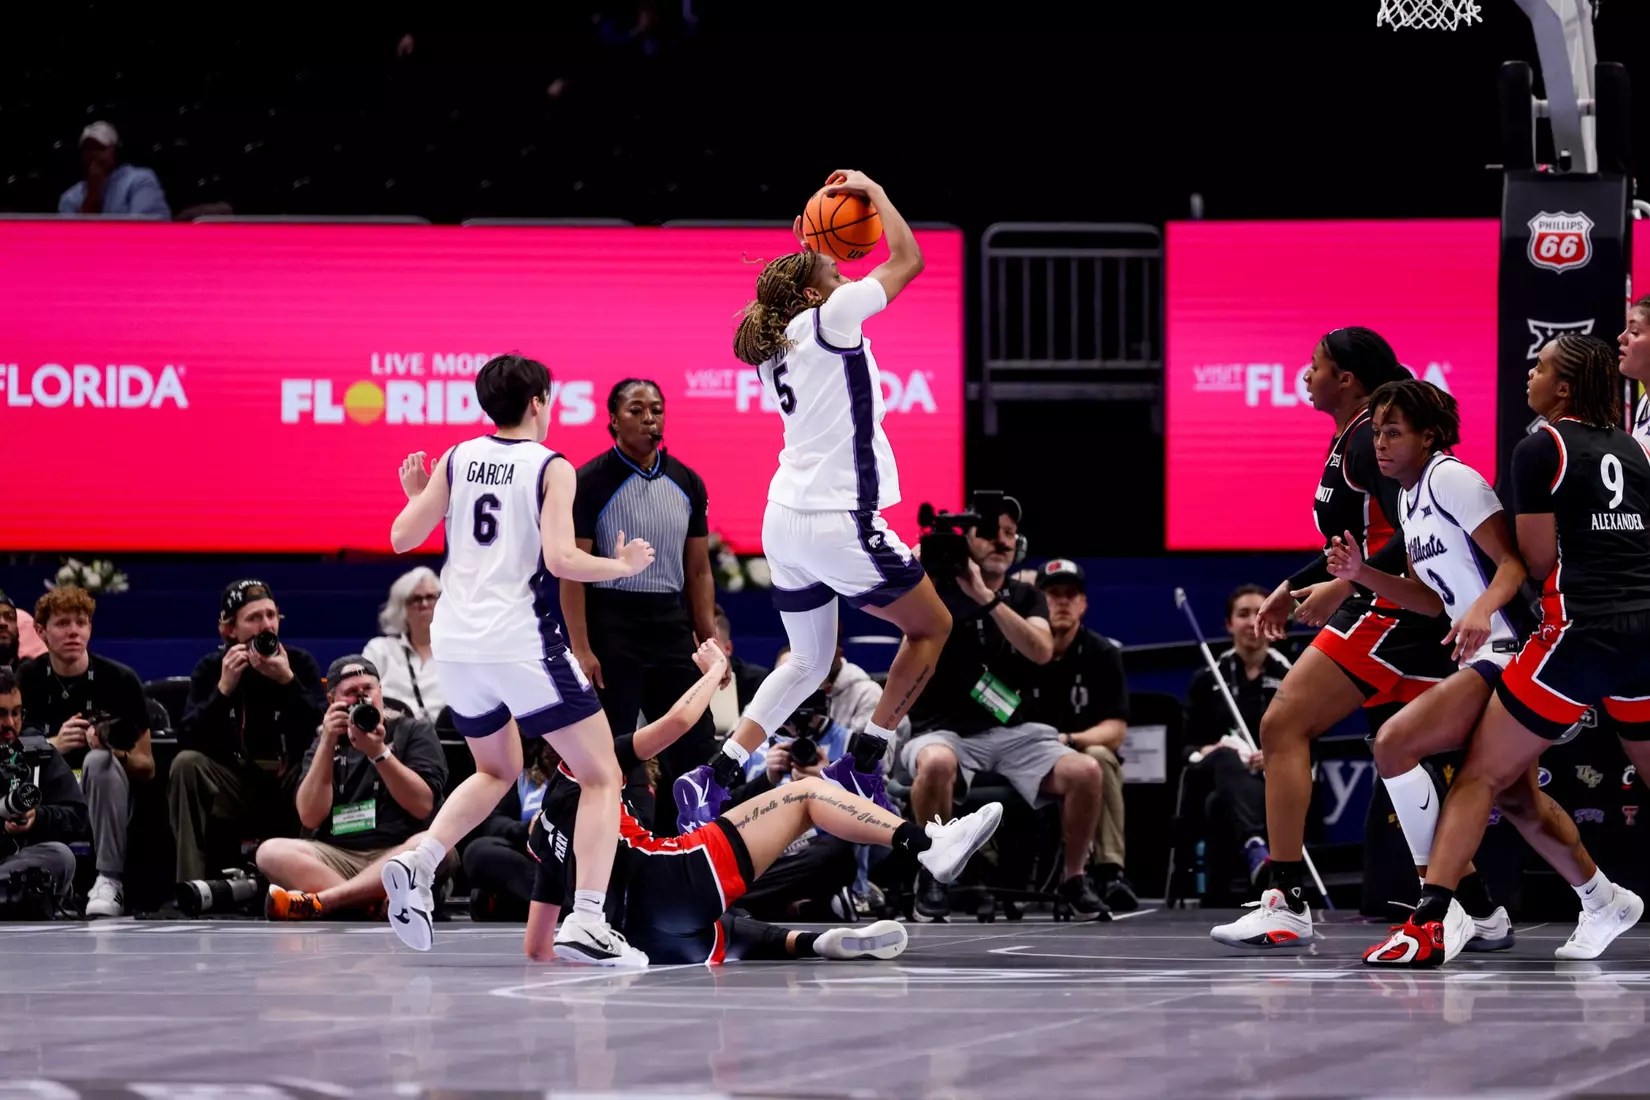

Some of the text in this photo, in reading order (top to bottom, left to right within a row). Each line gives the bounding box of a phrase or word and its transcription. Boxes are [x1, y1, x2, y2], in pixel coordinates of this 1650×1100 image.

[1538, 220, 1583, 231] PHILLIPS
[1540, 235, 1579, 259] 66
[371, 352, 503, 376] LIVE MOR
[1193, 365, 1244, 384] VISIT
[685, 369, 734, 389] VISIT
[773, 360, 798, 417] 5
[466, 461, 515, 486] GARCIA
[1600, 453, 1624, 509] 9
[473, 493, 502, 547] 6
[1591, 513, 1645, 530] ALEXANDER
[1427, 568, 1455, 606] 3
[554, 830, 569, 863] PERRY
